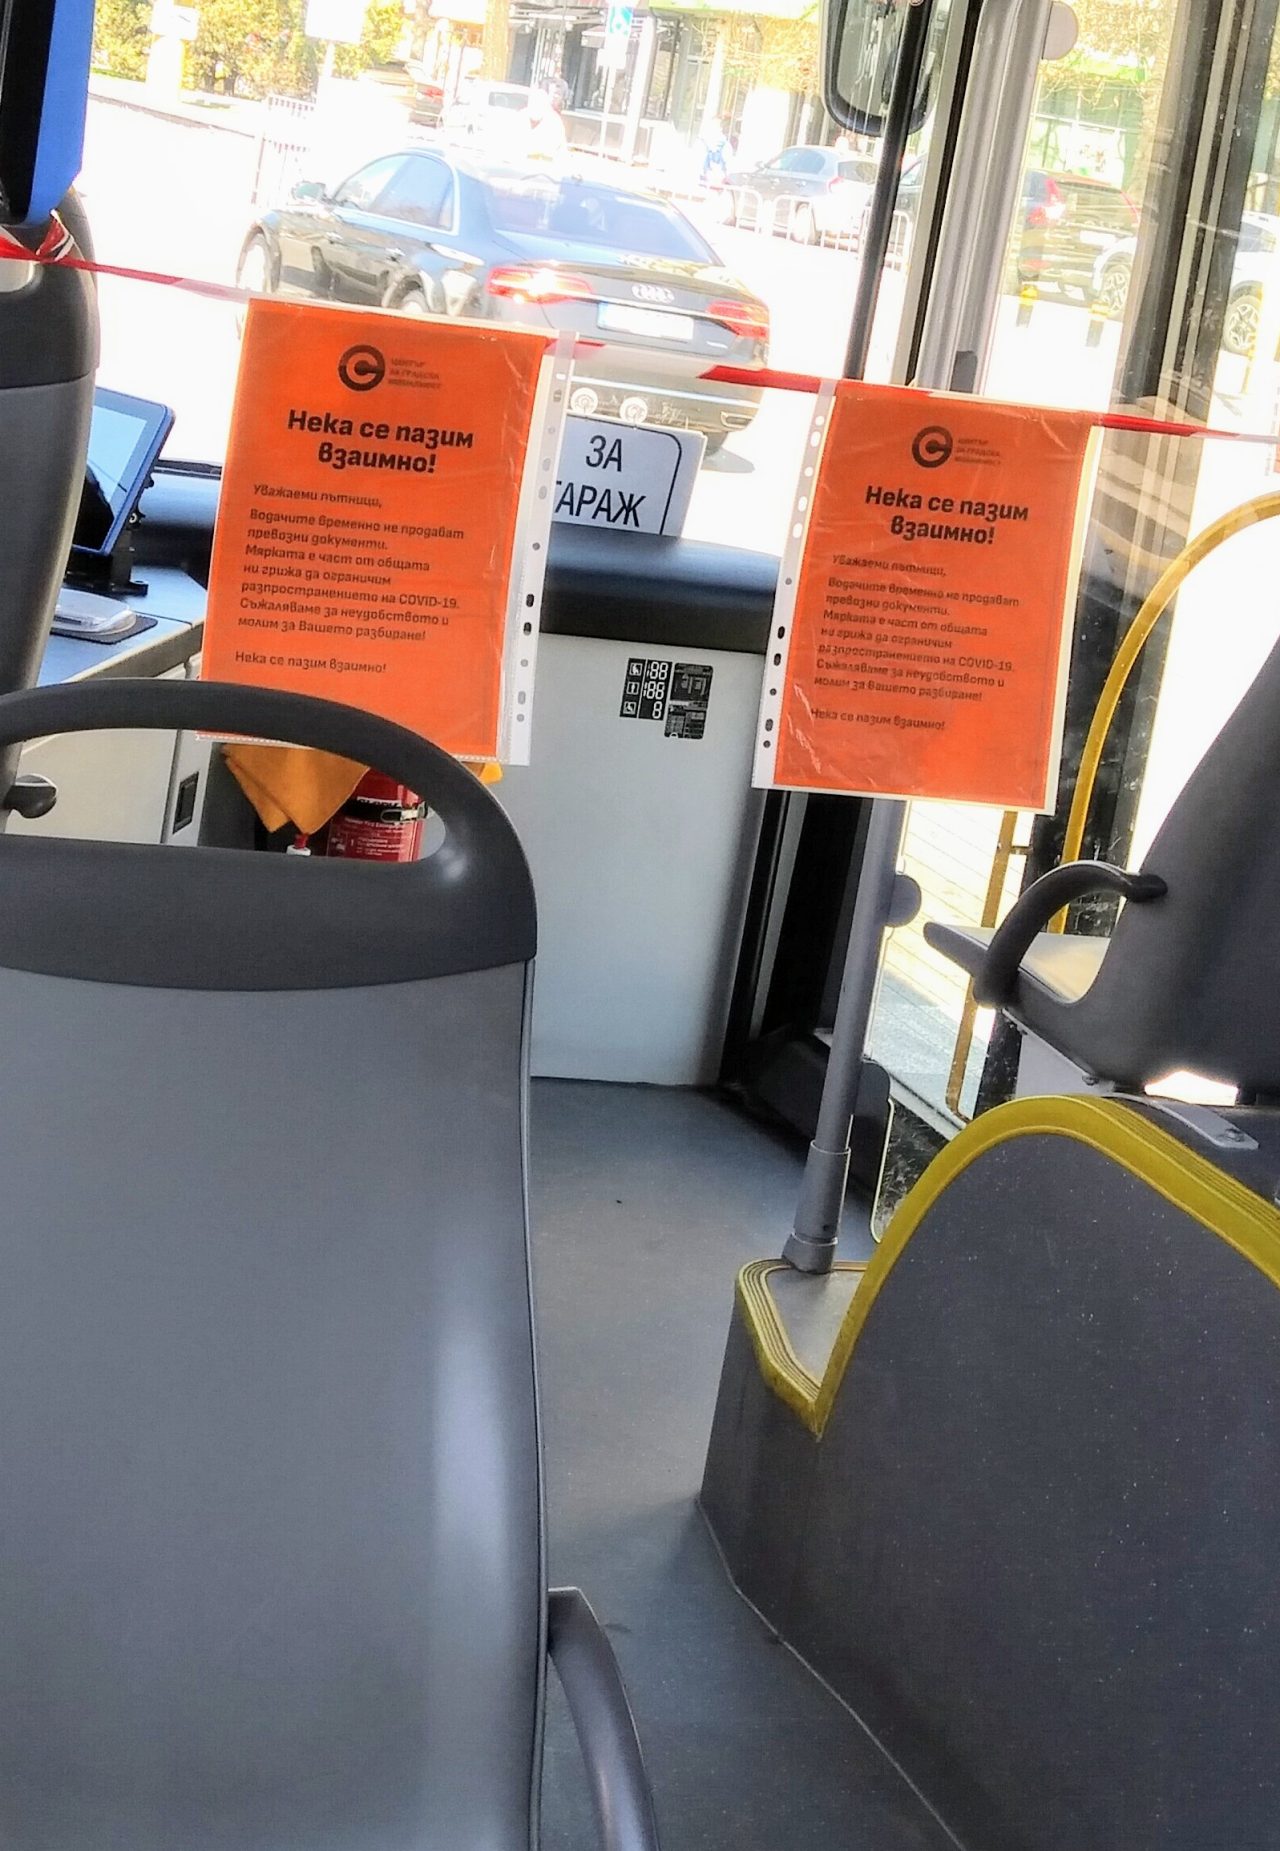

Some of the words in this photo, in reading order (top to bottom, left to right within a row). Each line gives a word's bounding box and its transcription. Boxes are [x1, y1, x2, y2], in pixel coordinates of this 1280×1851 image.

[288, 410, 352, 436] Нека
[359, 420, 390, 438] се
[396, 426, 474, 450] пазим
[318, 442, 436, 473] взаимно!
[586, 434, 622, 472] ЗА
[254, 485, 318, 500] Уважаеми
[555, 480, 646, 527] АРАЖ
[865, 486, 921, 509] Нека
[928, 497, 954, 512] се
[960, 499, 1028, 522] пазим
[248, 528, 308, 543] превозни
[250, 509, 315, 526] Водачите
[319, 515, 380, 531] временно
[384, 523, 397, 533] не
[401, 523, 464, 540] продават
[891, 515, 995, 544] взаимно!
[246, 545, 304, 561] Мярката
[308, 551, 315, 560] е
[319, 552, 352, 564] част
[356, 555, 375, 566] от
[378, 557, 429, 571] общата
[244, 564, 259, 573] ни
[262, 566, 301, 579] грижа
[305, 568, 319, 580] да
[323, 571, 391, 585] ограничим
[242, 582, 378, 602] разпространението
[382, 594, 395, 604] на
[826, 595, 880, 609] превозни
[828, 577, 886, 593] Водачите
[889, 582, 944, 599] временно
[947, 591, 959, 600] не
[962, 593, 1019, 607] продават
[240, 598, 320, 615] Съжаляваме
[324, 605, 337, 617] за
[341, 606, 438, 625] неудобството
[442, 616, 448, 625] и
[823, 610, 876, 624] Мярката
[879, 617, 885, 625] е
[888, 618, 918, 629] част
[921, 621, 938, 630] от
[941, 623, 987, 636] общата
[239, 618, 278, 629] молим
[281, 620, 295, 632] за
[299, 621, 352, 635] Вашето
[356, 625, 426, 641] разбиране!
[821, 628, 834, 636] ни
[837, 629, 873, 642] грижа
[876, 633, 888, 644] да
[892, 635, 952, 648] ограничим
[235, 652, 266, 665] Нека
[270, 655, 284, 665] се
[287, 657, 326, 670] пазим
[330, 659, 386, 673] взаимно!
[819, 645, 940, 665] разпространението
[943, 657, 955, 666] на
[817, 659, 889, 676] Съжаляваме
[892, 667, 903, 678] за
[906, 668, 994, 687] неудобството
[998, 678, 1004, 687] и
[815, 677, 850, 687] молим
[852, 680, 865, 691] за
[919, 686, 982, 700] разбиране!
[652, 701, 662, 719] 8
[811, 708, 838, 720] Нека
[841, 712, 853, 722] се
[857, 714, 891, 726] пазим
[894, 716, 945, 730] взаимно!
